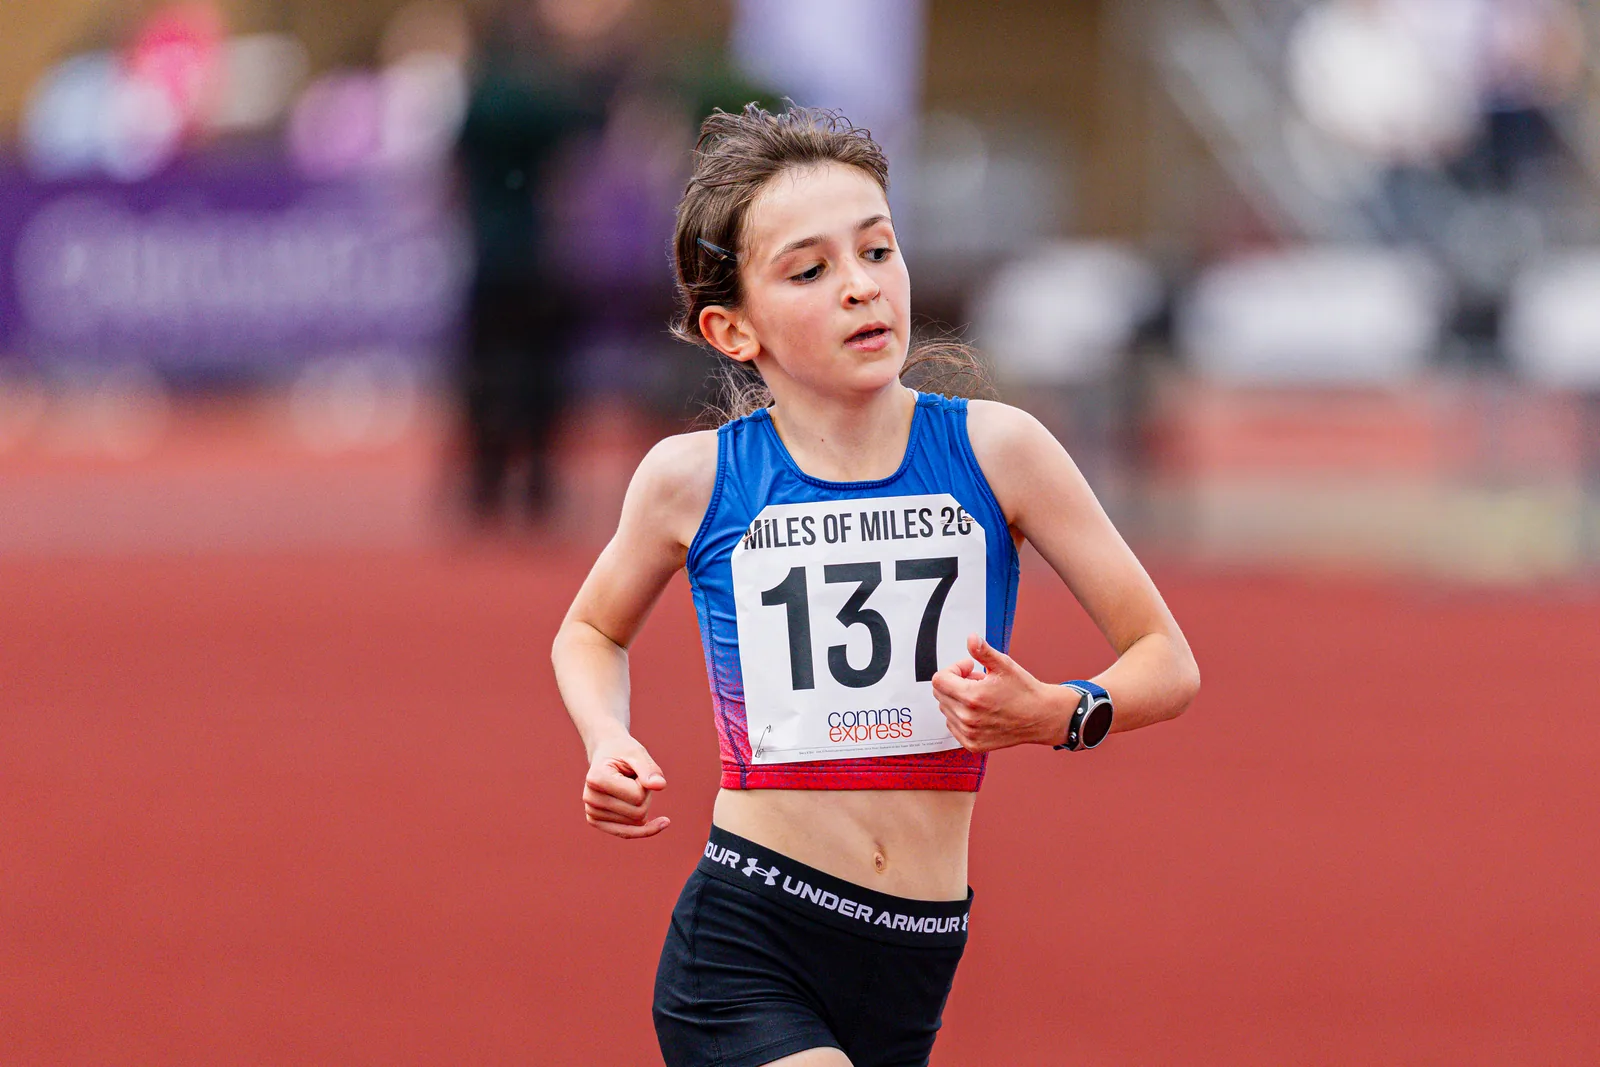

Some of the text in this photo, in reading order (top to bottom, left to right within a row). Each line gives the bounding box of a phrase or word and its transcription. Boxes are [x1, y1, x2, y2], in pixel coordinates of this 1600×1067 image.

[743, 516, 817, 550] MILES
[823, 513, 852, 544] OF
[859, 507, 933, 542] MILES
[761, 556, 959, 691] 137
[827, 707, 912, 729] comms
[829, 721, 913, 743] express
[782, 875, 873, 922] UNDER
[873, 911, 960, 933] ARMOUR
